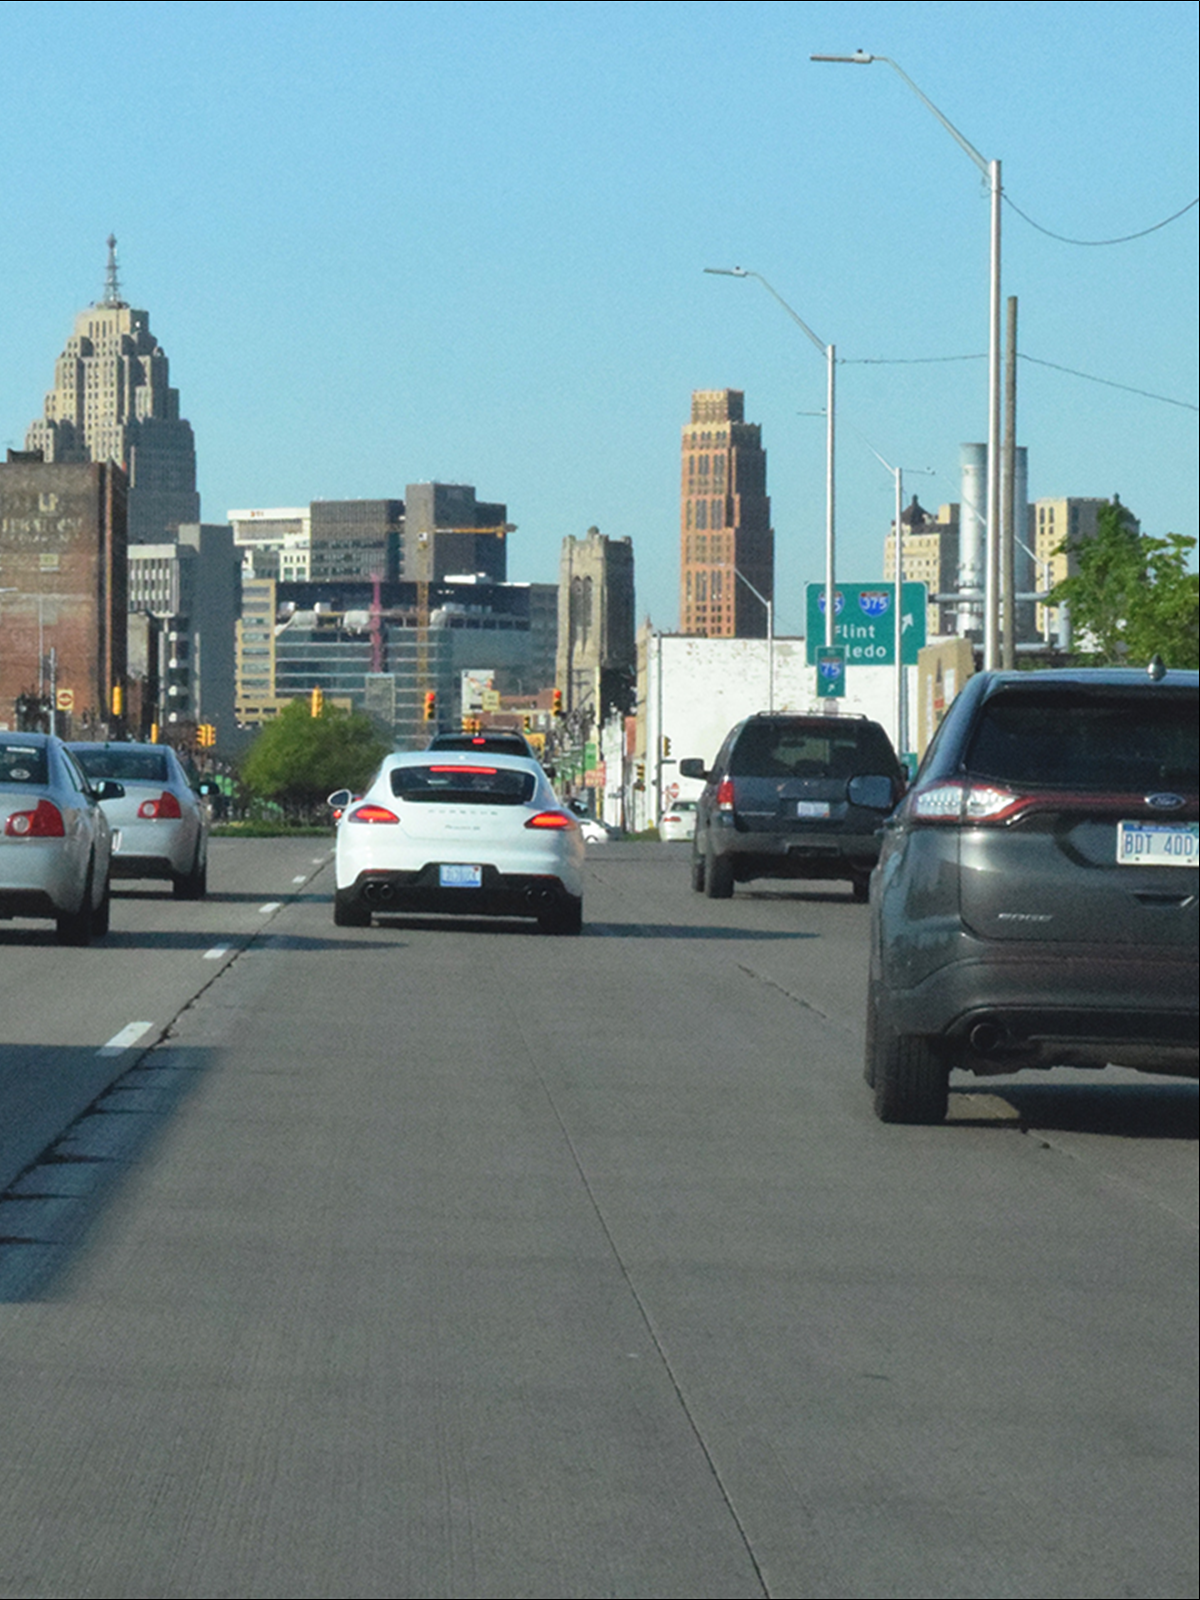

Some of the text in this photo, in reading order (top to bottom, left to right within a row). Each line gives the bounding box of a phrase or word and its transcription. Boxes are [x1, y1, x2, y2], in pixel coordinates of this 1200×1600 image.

[862, 596, 888, 610] 375
[845, 644, 887, 658] ledo
[822, 663, 840, 674] 75
[1125, 833, 1152, 854] BDT
